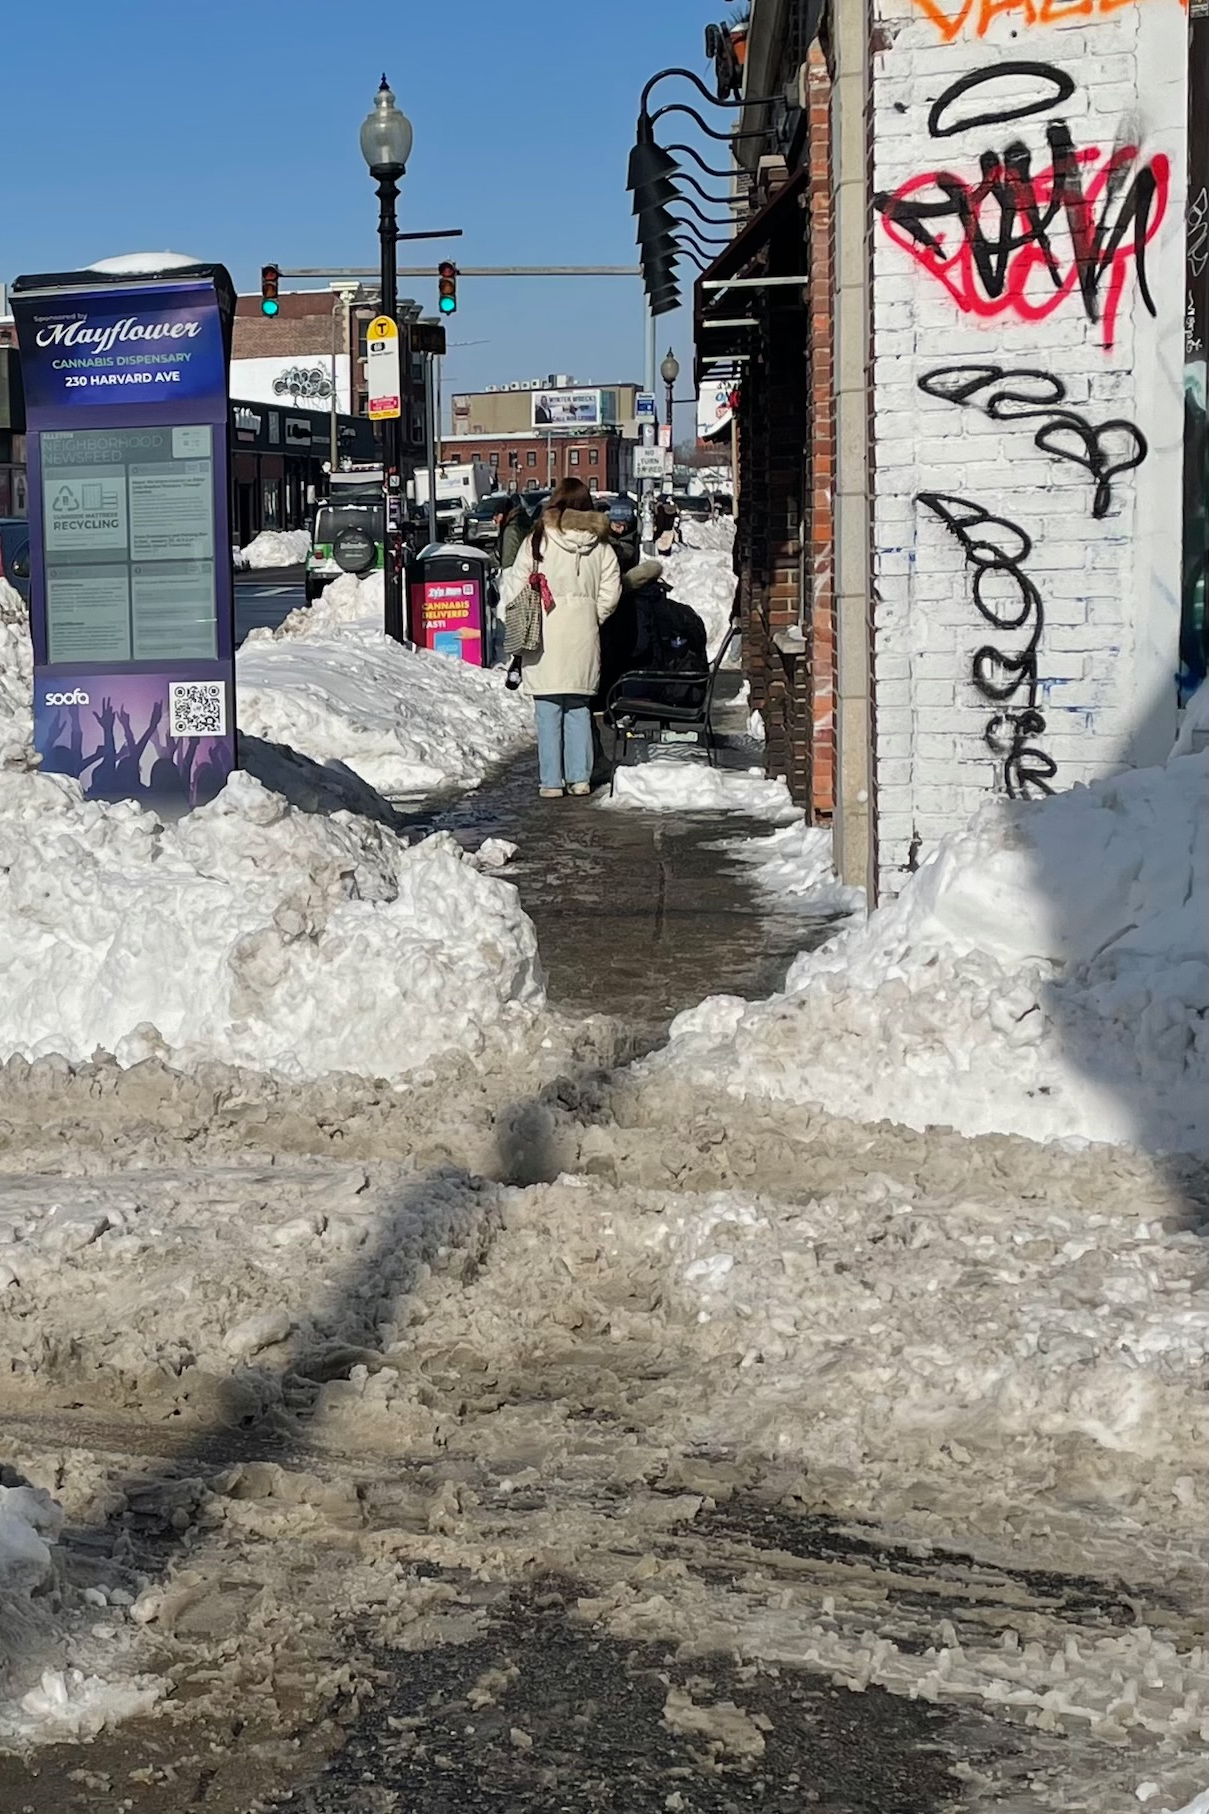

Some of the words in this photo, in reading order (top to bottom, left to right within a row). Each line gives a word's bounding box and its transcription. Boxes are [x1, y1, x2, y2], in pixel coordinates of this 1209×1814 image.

[33, 314, 76, 323] Sponsored
[77, 312, 88, 321] by
[35, 316, 202, 355] Mayflower
[377, 323, 387, 334] T
[52, 356, 114, 369] CANNABIS
[117, 353, 192, 366] DISPENSARY
[65, 375, 87, 387] 230
[90, 372, 152, 386] HARVARD
[155, 371, 181, 382] AVE
[42, 435, 164, 451] NEIGHBORHOOD
[43, 450, 123, 465] NEWSFEED
[53, 518, 119, 531] RECYCLING
[422, 600, 470, 610] CANNABIS
[422, 610, 469, 619] DELIVERED
[45, 687, 89, 706] soofa
